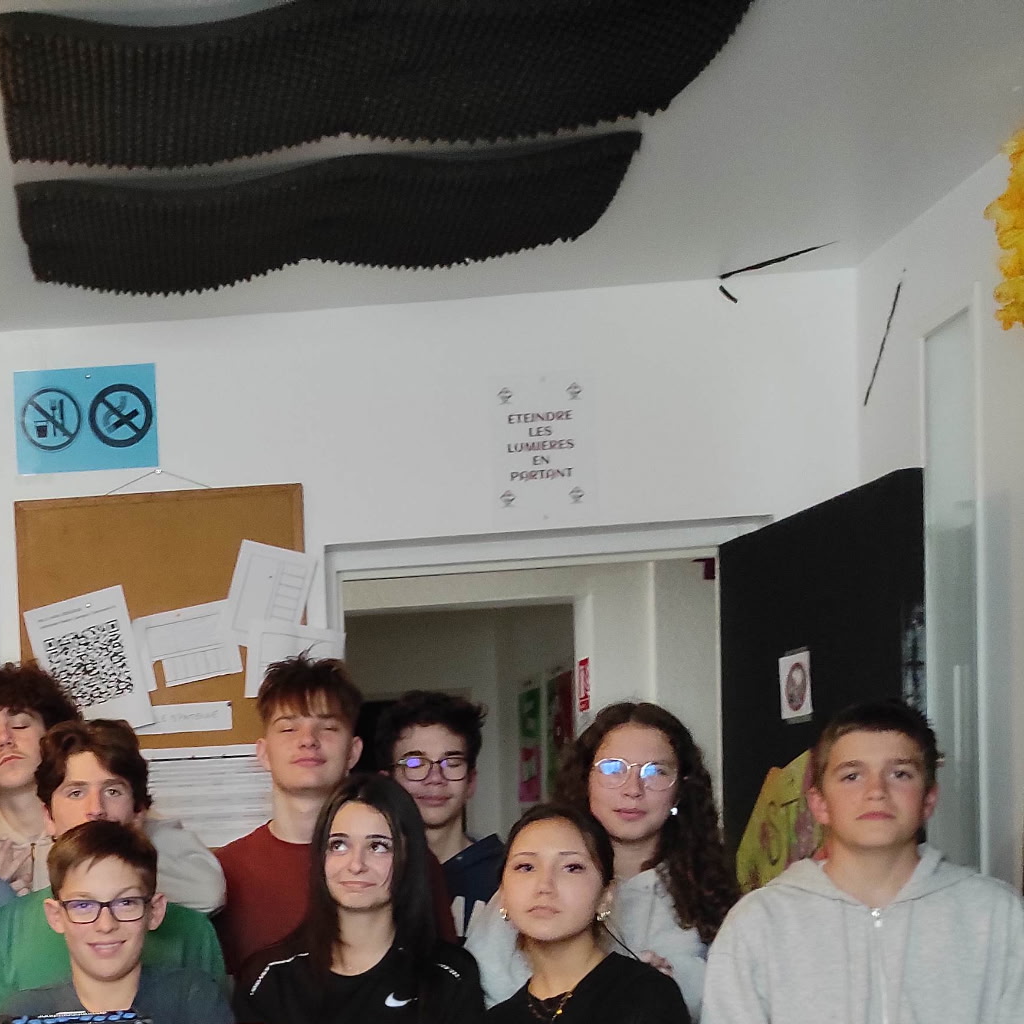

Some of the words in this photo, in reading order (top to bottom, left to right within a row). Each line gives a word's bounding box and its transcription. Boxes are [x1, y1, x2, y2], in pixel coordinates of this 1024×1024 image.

[507, 410, 574, 425] ETEINDRE
[528, 425, 553, 438] LES
[507, 438, 575, 454] LUMIERES
[532, 455, 550, 466] EN
[509, 467, 574, 482] PARTANT
